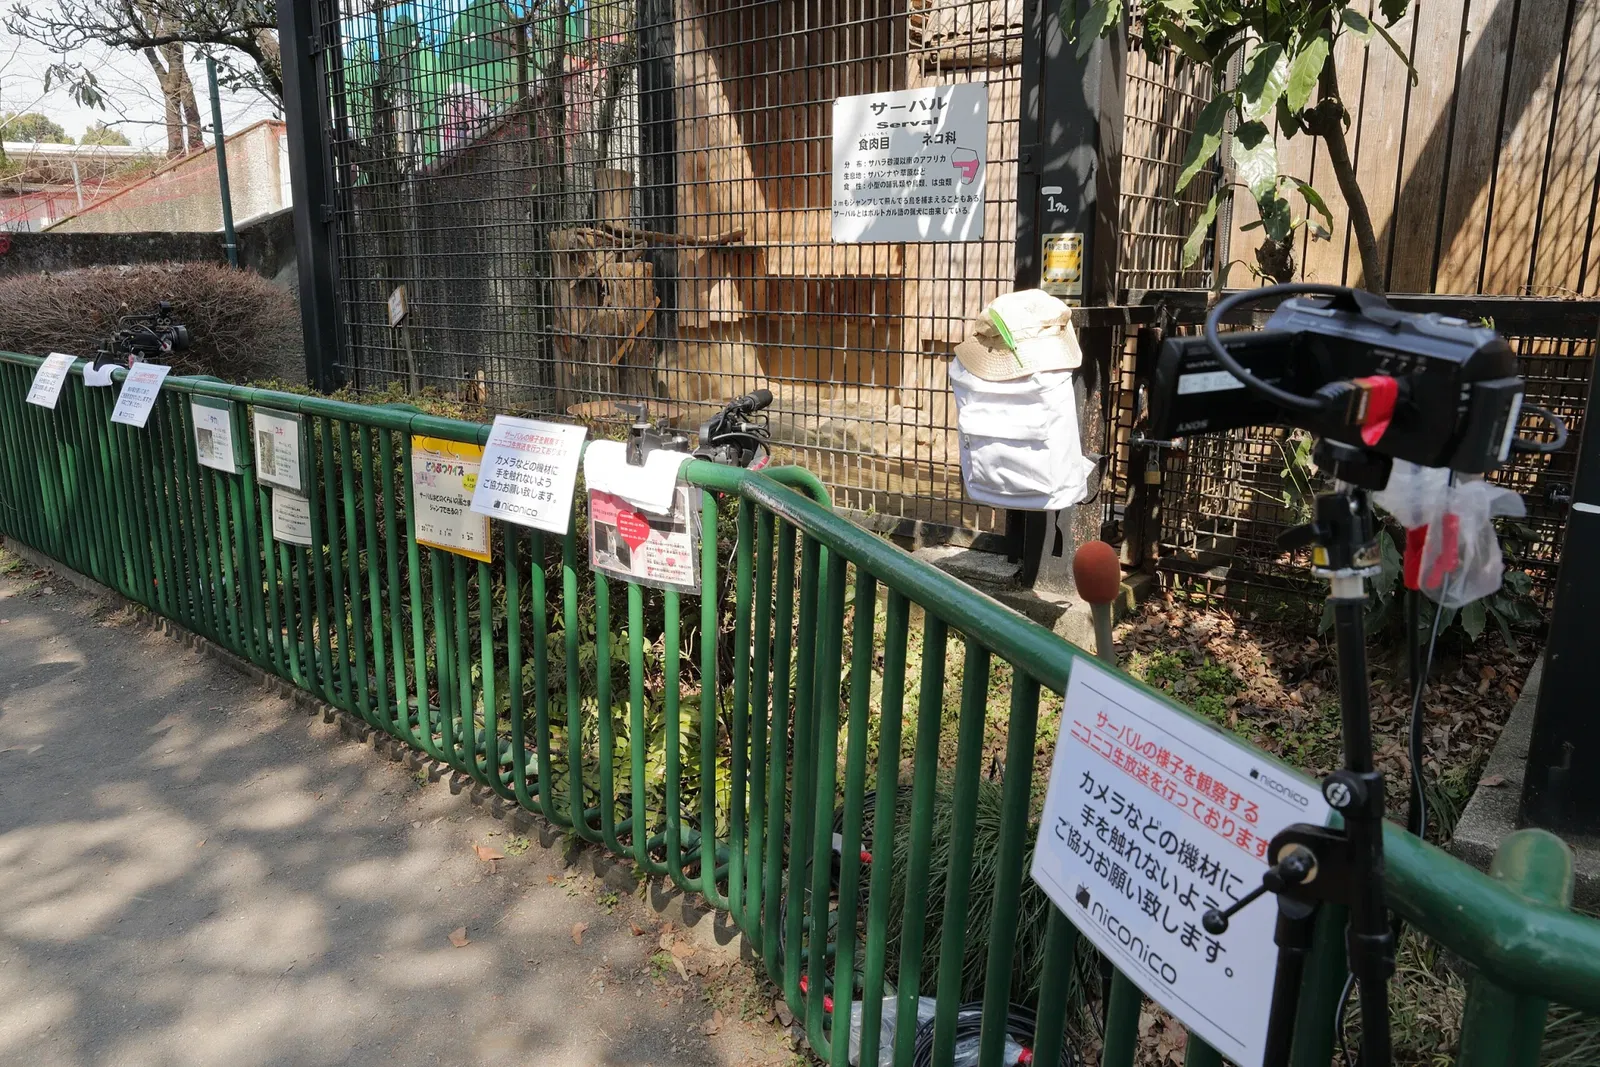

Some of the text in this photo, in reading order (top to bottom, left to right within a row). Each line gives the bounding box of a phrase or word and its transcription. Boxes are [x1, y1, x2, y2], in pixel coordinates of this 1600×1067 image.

[870, 97, 947, 116] サーバル
[876, 117, 938, 129] Serval
[858, 131, 957, 151] 食肉目 ネコ科
[495, 455, 559, 475] カメラなどの機材に
[495, 468, 552, 488] 手を触れないよう
[483, 479, 556, 503] ご協力お願い致します。
[500, 502, 538, 517] niconico
[1096, 709, 1260, 823] サーバルの様子を観察する
[1070, 717, 1271, 859] ニコニコ生放送を行っております
[1259, 774, 1309, 807] niconico
[1079, 770, 1244, 900] カメラなどの機材に
[1053, 816, 1234, 979] ご協力お願い致します。
[1091, 900, 1178, 986] niconico
